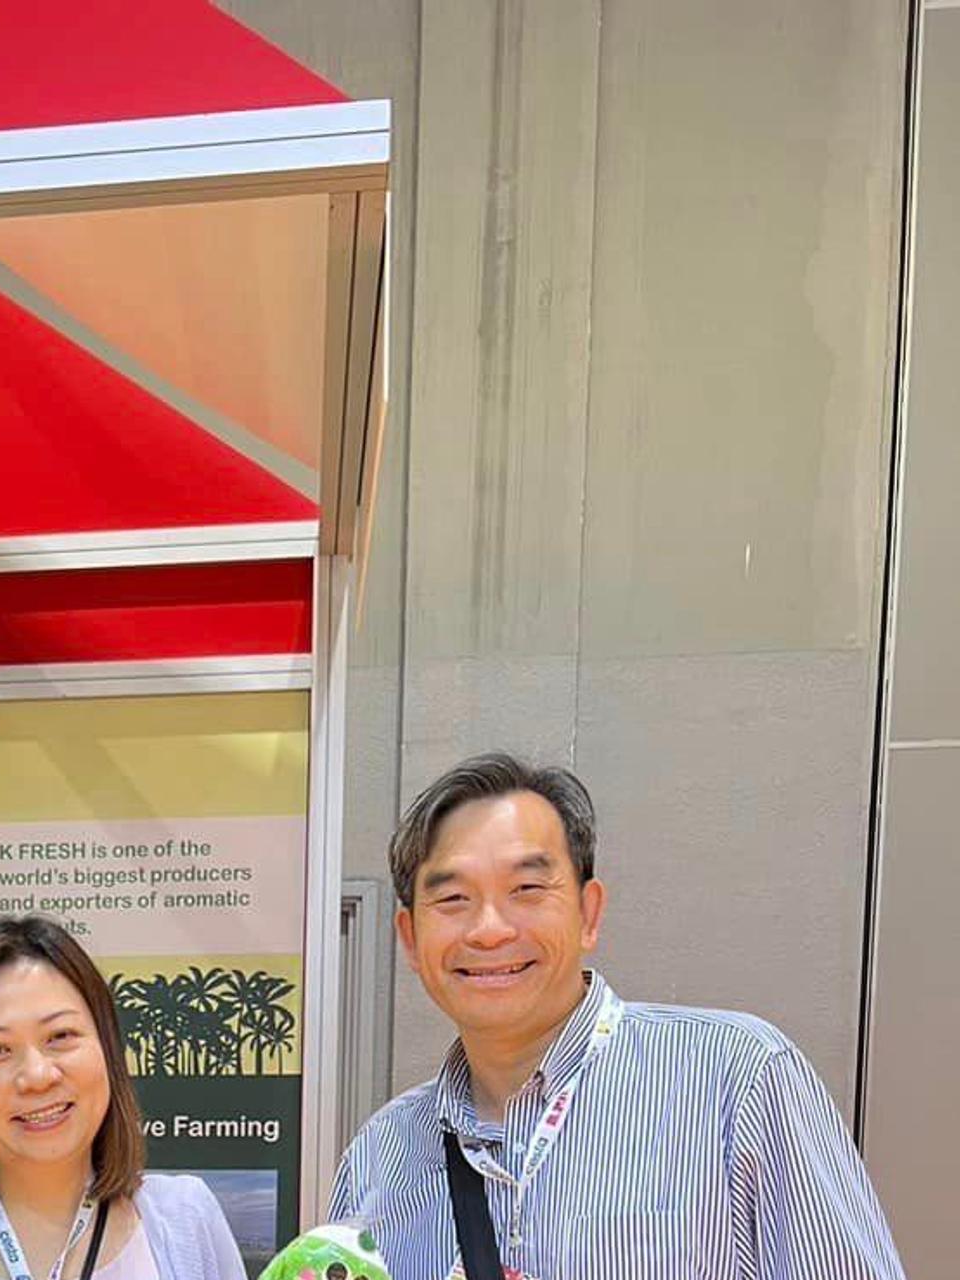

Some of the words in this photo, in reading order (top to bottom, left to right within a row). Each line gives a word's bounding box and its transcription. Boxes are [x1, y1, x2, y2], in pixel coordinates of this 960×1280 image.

[0, 843, 13, 860] K
[18, 843, 86, 860] FRESH
[91, 843, 107, 859] is
[112, 845, 148, 859] one
[153, 841, 175, 858] of
[180, 840, 211, 857] the
[0, 868, 69, 885] world's
[74, 867, 145, 887] biggest
[151, 866, 252, 885] producers
[0, 894, 34, 911] and
[40, 893, 132, 914] exporters
[137, 892, 159, 908] of
[163, 891, 251, 908] aromatic
[173, 1115, 280, 1142] Farming
